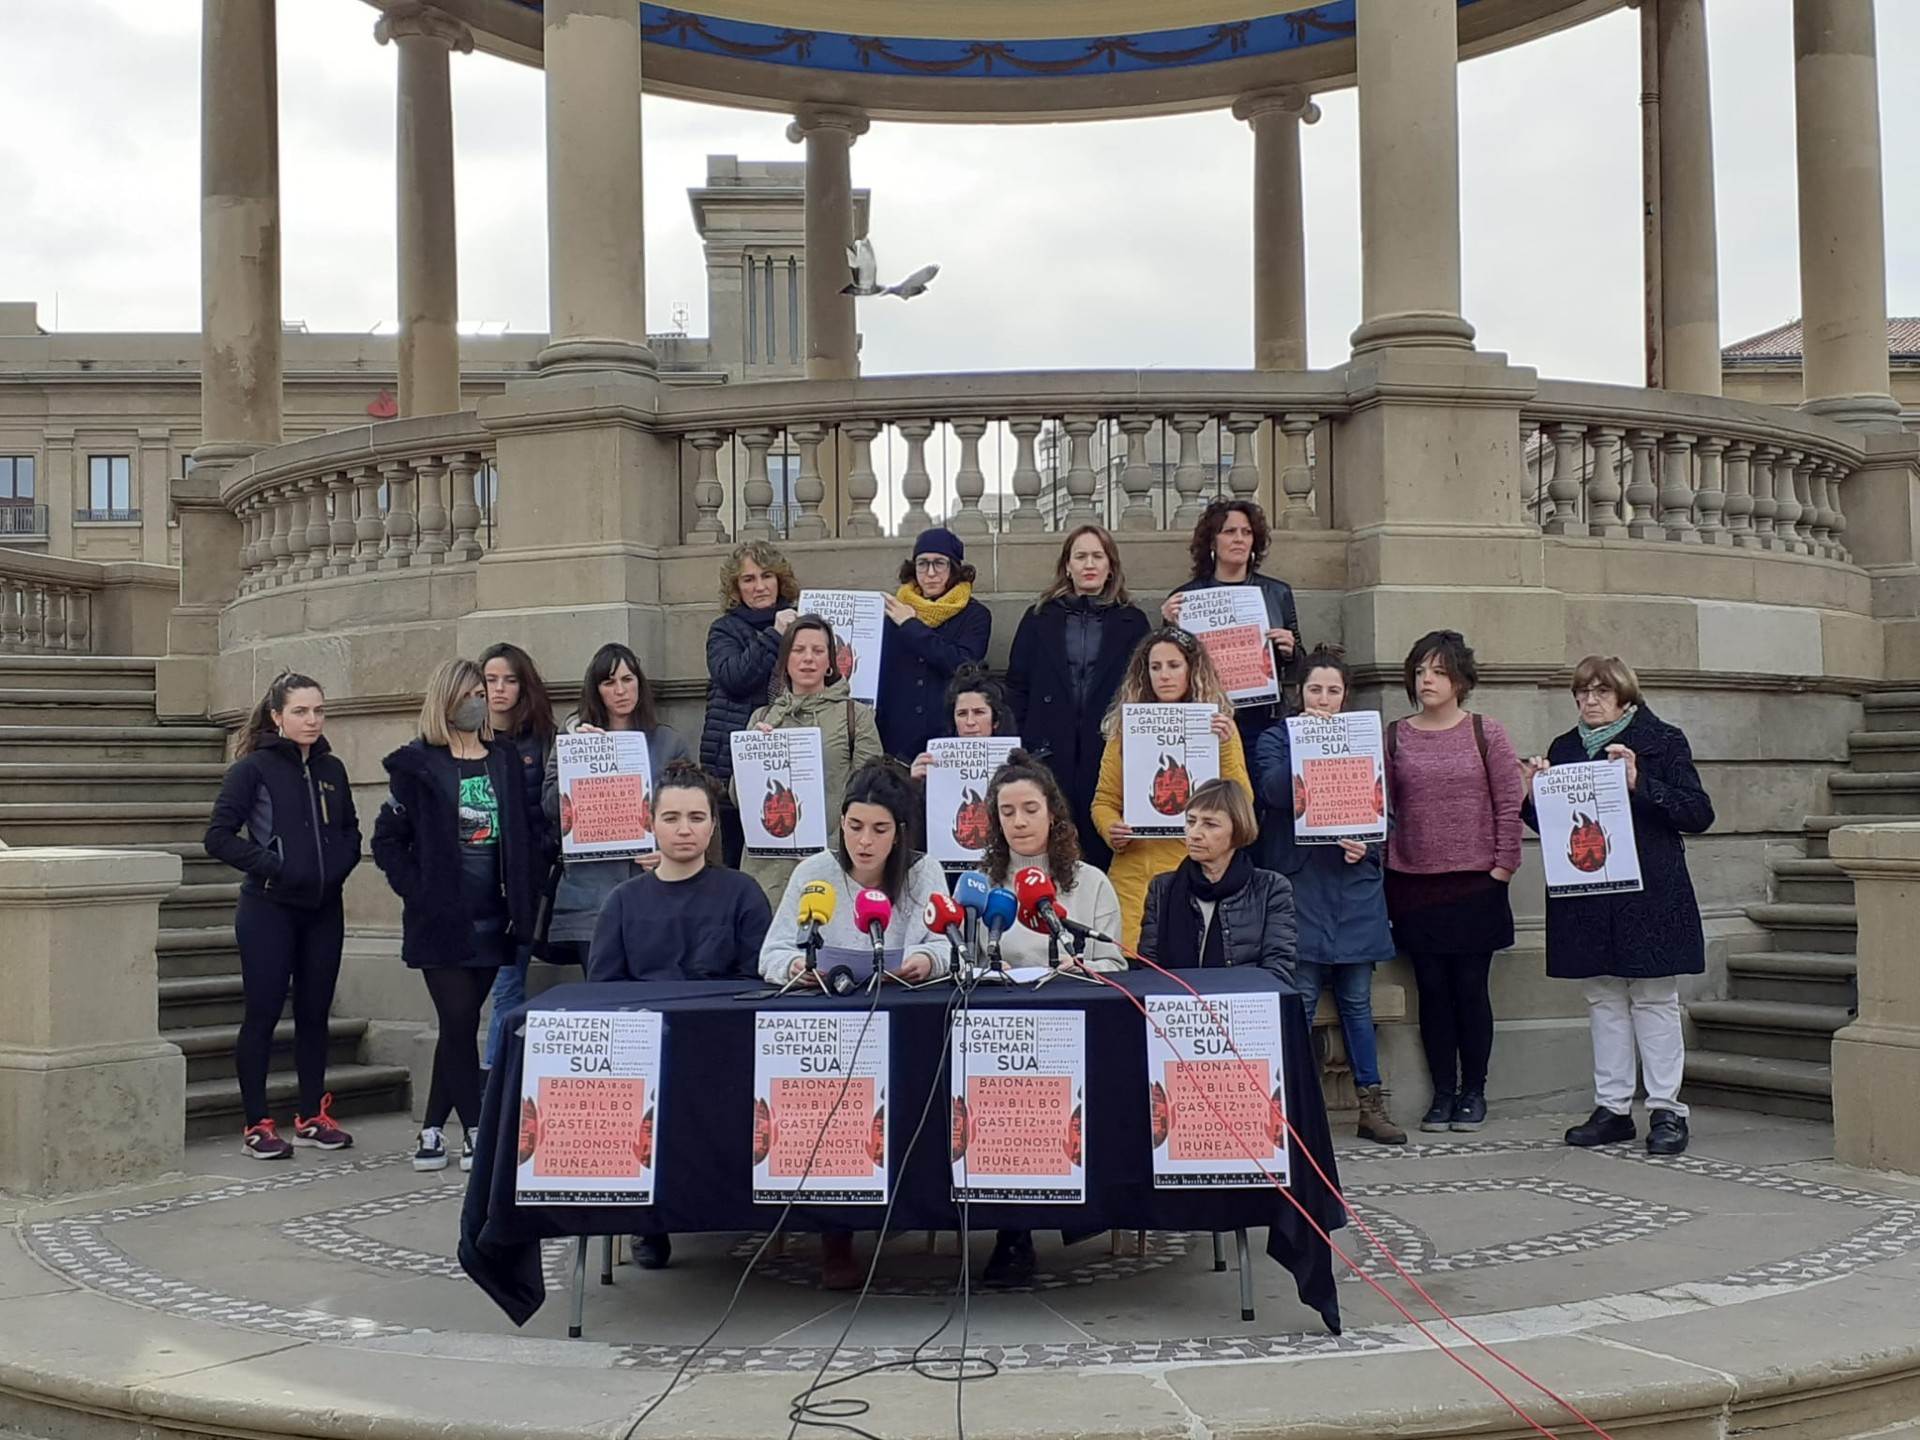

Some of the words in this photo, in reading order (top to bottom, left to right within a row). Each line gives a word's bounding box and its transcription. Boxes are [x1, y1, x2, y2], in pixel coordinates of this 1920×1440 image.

[1183, 591, 1230, 603] APALTZEN
[1189, 598, 1231, 611] GAITUEN
[1183, 606, 1232, 620] SISTEMARI
[828, 616, 854, 626] SUA
[1209, 615, 1237, 627] SUA
[1126, 707, 1183, 716] ZAPALTZEN
[1138, 717, 1183, 725] GAITUEN
[1130, 726, 1183, 734] SISTEMARI
[1302, 726, 1346, 734] GAITUEN
[558, 736, 613, 747] ZAPALTZEN
[1157, 735, 1186, 746] SUA
[1295, 734, 1346, 744] SISTEMARI
[570, 745, 614, 755] GAITUEN
[745, 742, 787, 751] GAITUEN
[930, 742, 986, 750] ZAPALTZEN
[1321, 744, 1350, 755] SUA
[562, 753, 615, 764] SISTEMARI
[738, 751, 787, 761] SISTEMARI
[941, 751, 986, 759] GAITUEN
[590, 763, 619, 774] SUA
[763, 760, 791, 771] SUA
[1311, 759, 1348, 767] BAIONA
[960, 769, 989, 779] SUA
[1332, 772, 1367, 780] BILBO
[1548, 774, 1591, 785] GAITUEN
[599, 790, 635, 798] BILBO
[1311, 786, 1351, 794] GASTEIZ
[1540, 783, 1592, 795] SISTEMARI
[1330, 798, 1371, 807] DONOSTI
[1567, 792, 1596, 804] SUA
[578, 803, 619, 812] GASTEIZ
[967, 878, 986, 892] tve
[1148, 1001, 1229, 1013] ZAPALTZEN
[529, 1017, 609, 1029] ZAPALTZEN
[758, 1018, 837, 1029] ZAPALTZEN
[955, 1016, 1034, 1027] ZAPALTZEN
[1166, 1013, 1230, 1025] GAITUEN
[545, 1031, 609, 1042] GAITUEN
[774, 1032, 837, 1042] GAITUEN
[971, 1030, 1034, 1041] GAITUEN
[1154, 1026, 1230, 1038] SISTEMARI
[532, 1043, 608, 1054] SISTEMARI
[762, 1044, 836, 1055] SISTEMARI
[959, 1042, 1034, 1053] SISTEMARI
[1194, 1039, 1237, 1055] SUA
[570, 1057, 612, 1072] SUA
[800, 1057, 841, 1072] SUA
[997, 1055, 1039, 1071] SUA
[1177, 1062, 1231, 1072] BAIONA
[551, 1080, 605, 1089] BAIONA
[782, 1080, 836, 1090] BAIONA
[980, 1078, 1033, 1088] BAIONA
[1208, 1082, 1259, 1092] BILBO
[579, 1101, 632, 1111] BILBO
[812, 1100, 863, 1110] BILBO
[1009, 1099, 1060, 1109] BILBO
[1177, 1102, 1236, 1112] GASTEIZ
[546, 1119, 607, 1130] GASTEIZ
[978, 1117, 1036, 1127] GASTEIZ
[573, 1140, 632, 1149] DONOSTI
[806, 1139, 864, 1148] DONOSTI
[1004, 1138, 1062, 1147] DONOSTI
[1179, 1138, 1232, 1151] IRUÑEA
[544, 1156, 598, 1168] IRUÑEA
[977, 1154, 1030, 1166] IRUÑEA
